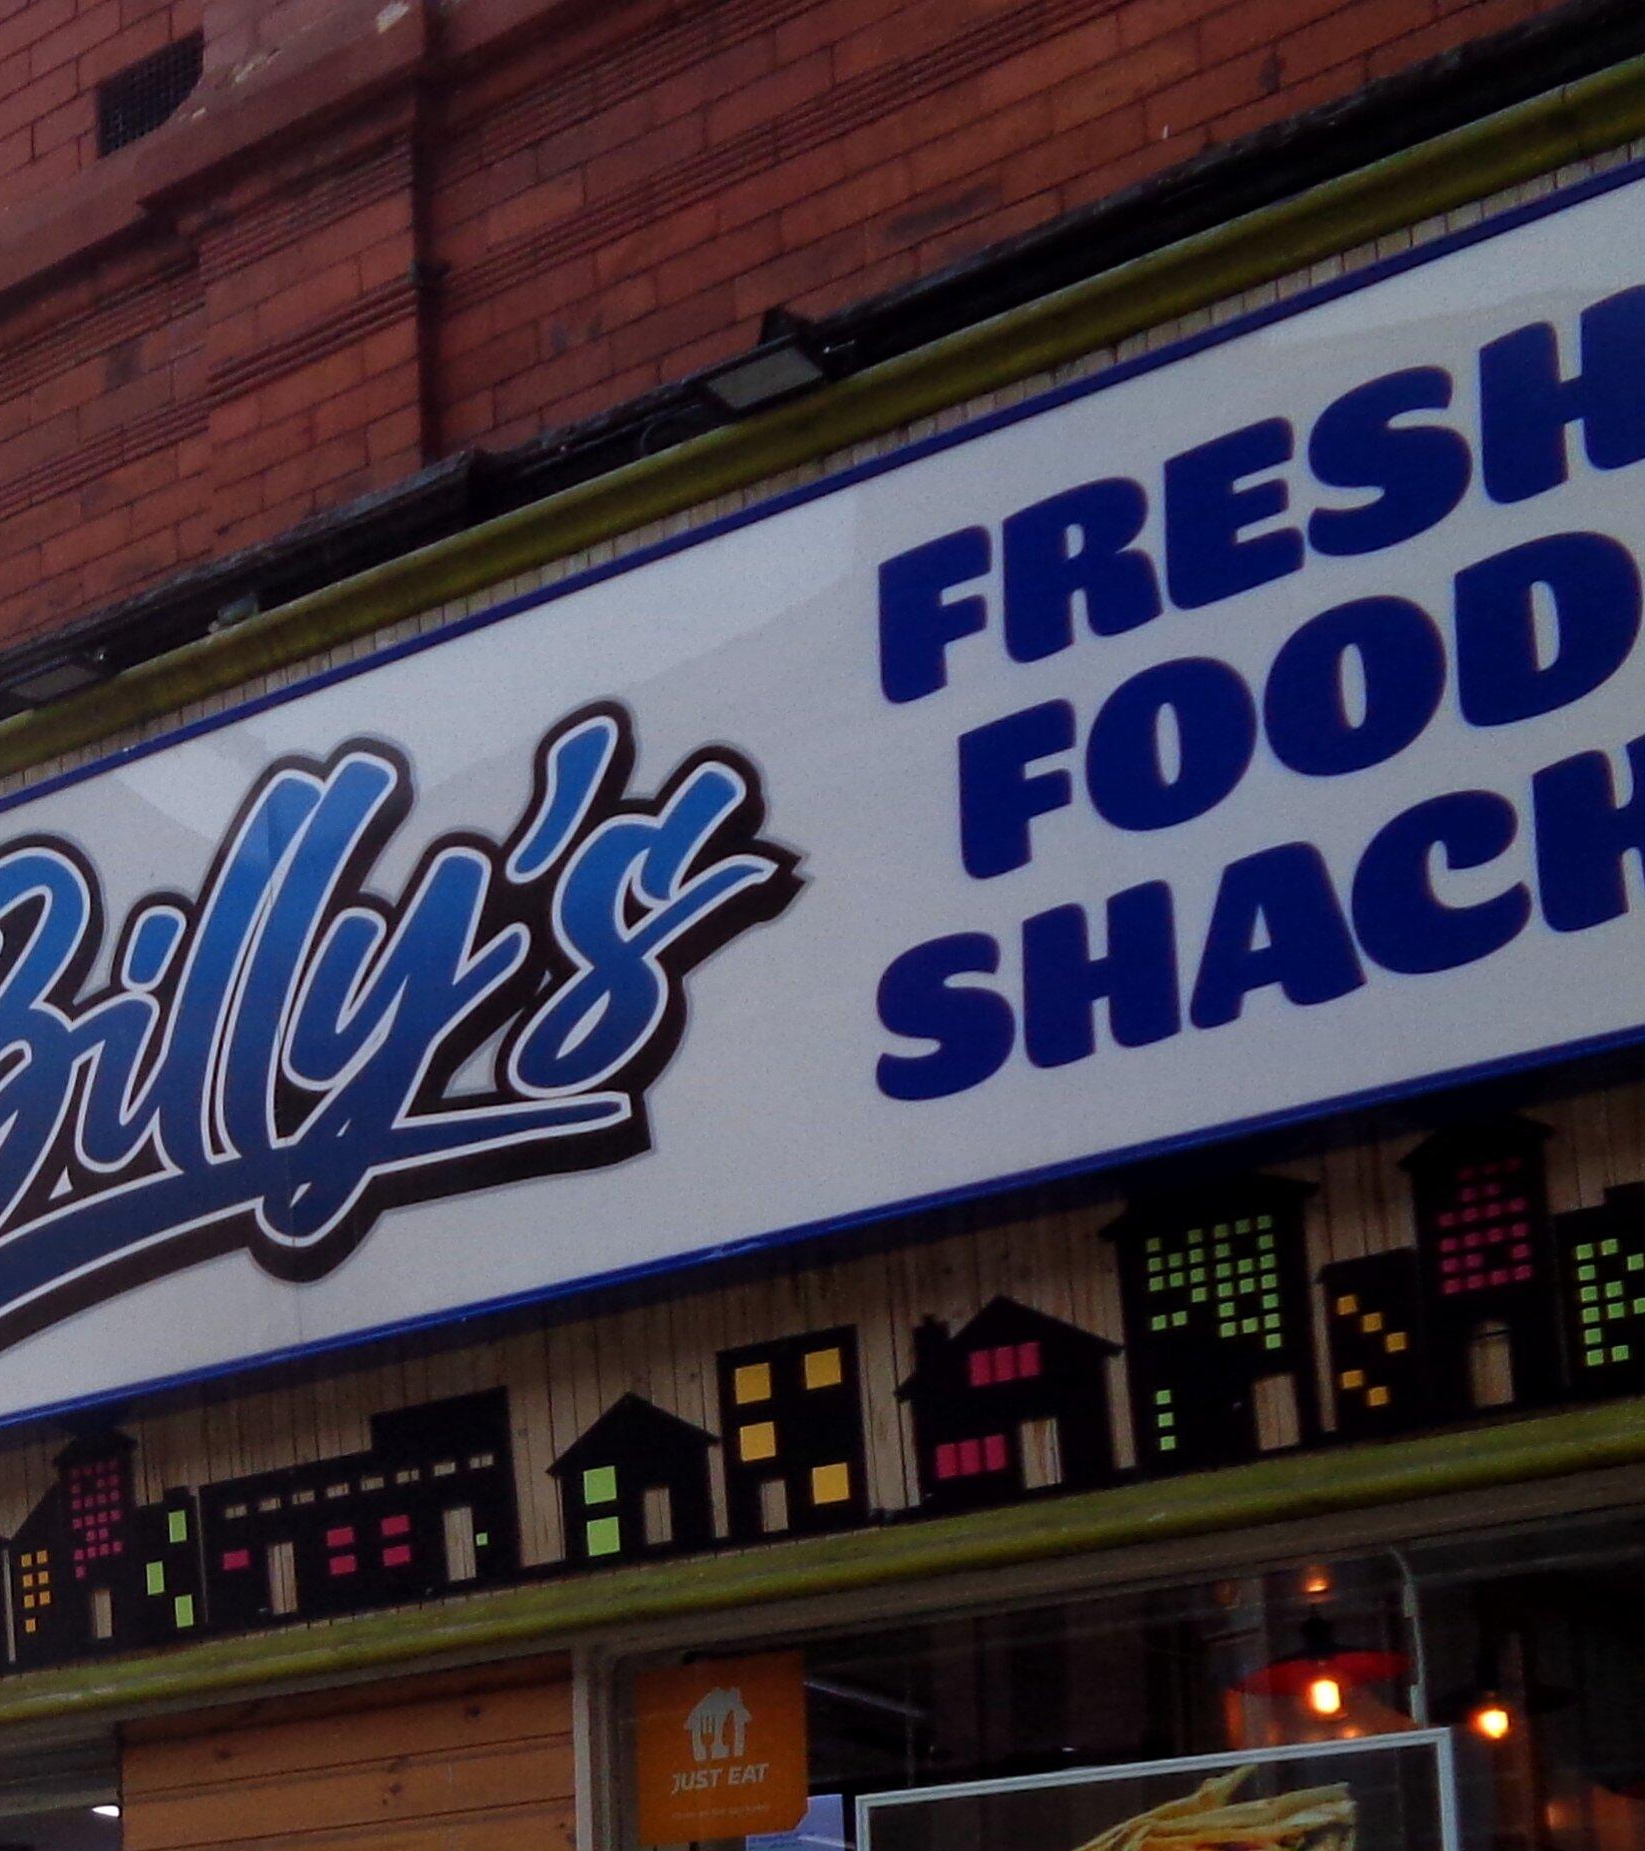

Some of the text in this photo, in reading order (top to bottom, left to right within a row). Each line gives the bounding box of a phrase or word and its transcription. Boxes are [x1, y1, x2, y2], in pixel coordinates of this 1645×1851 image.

[879, 284, 1645, 704] FRESH
[958, 531, 1643, 880] FOOD
[671, 1762, 770, 1795] JUST EAT
